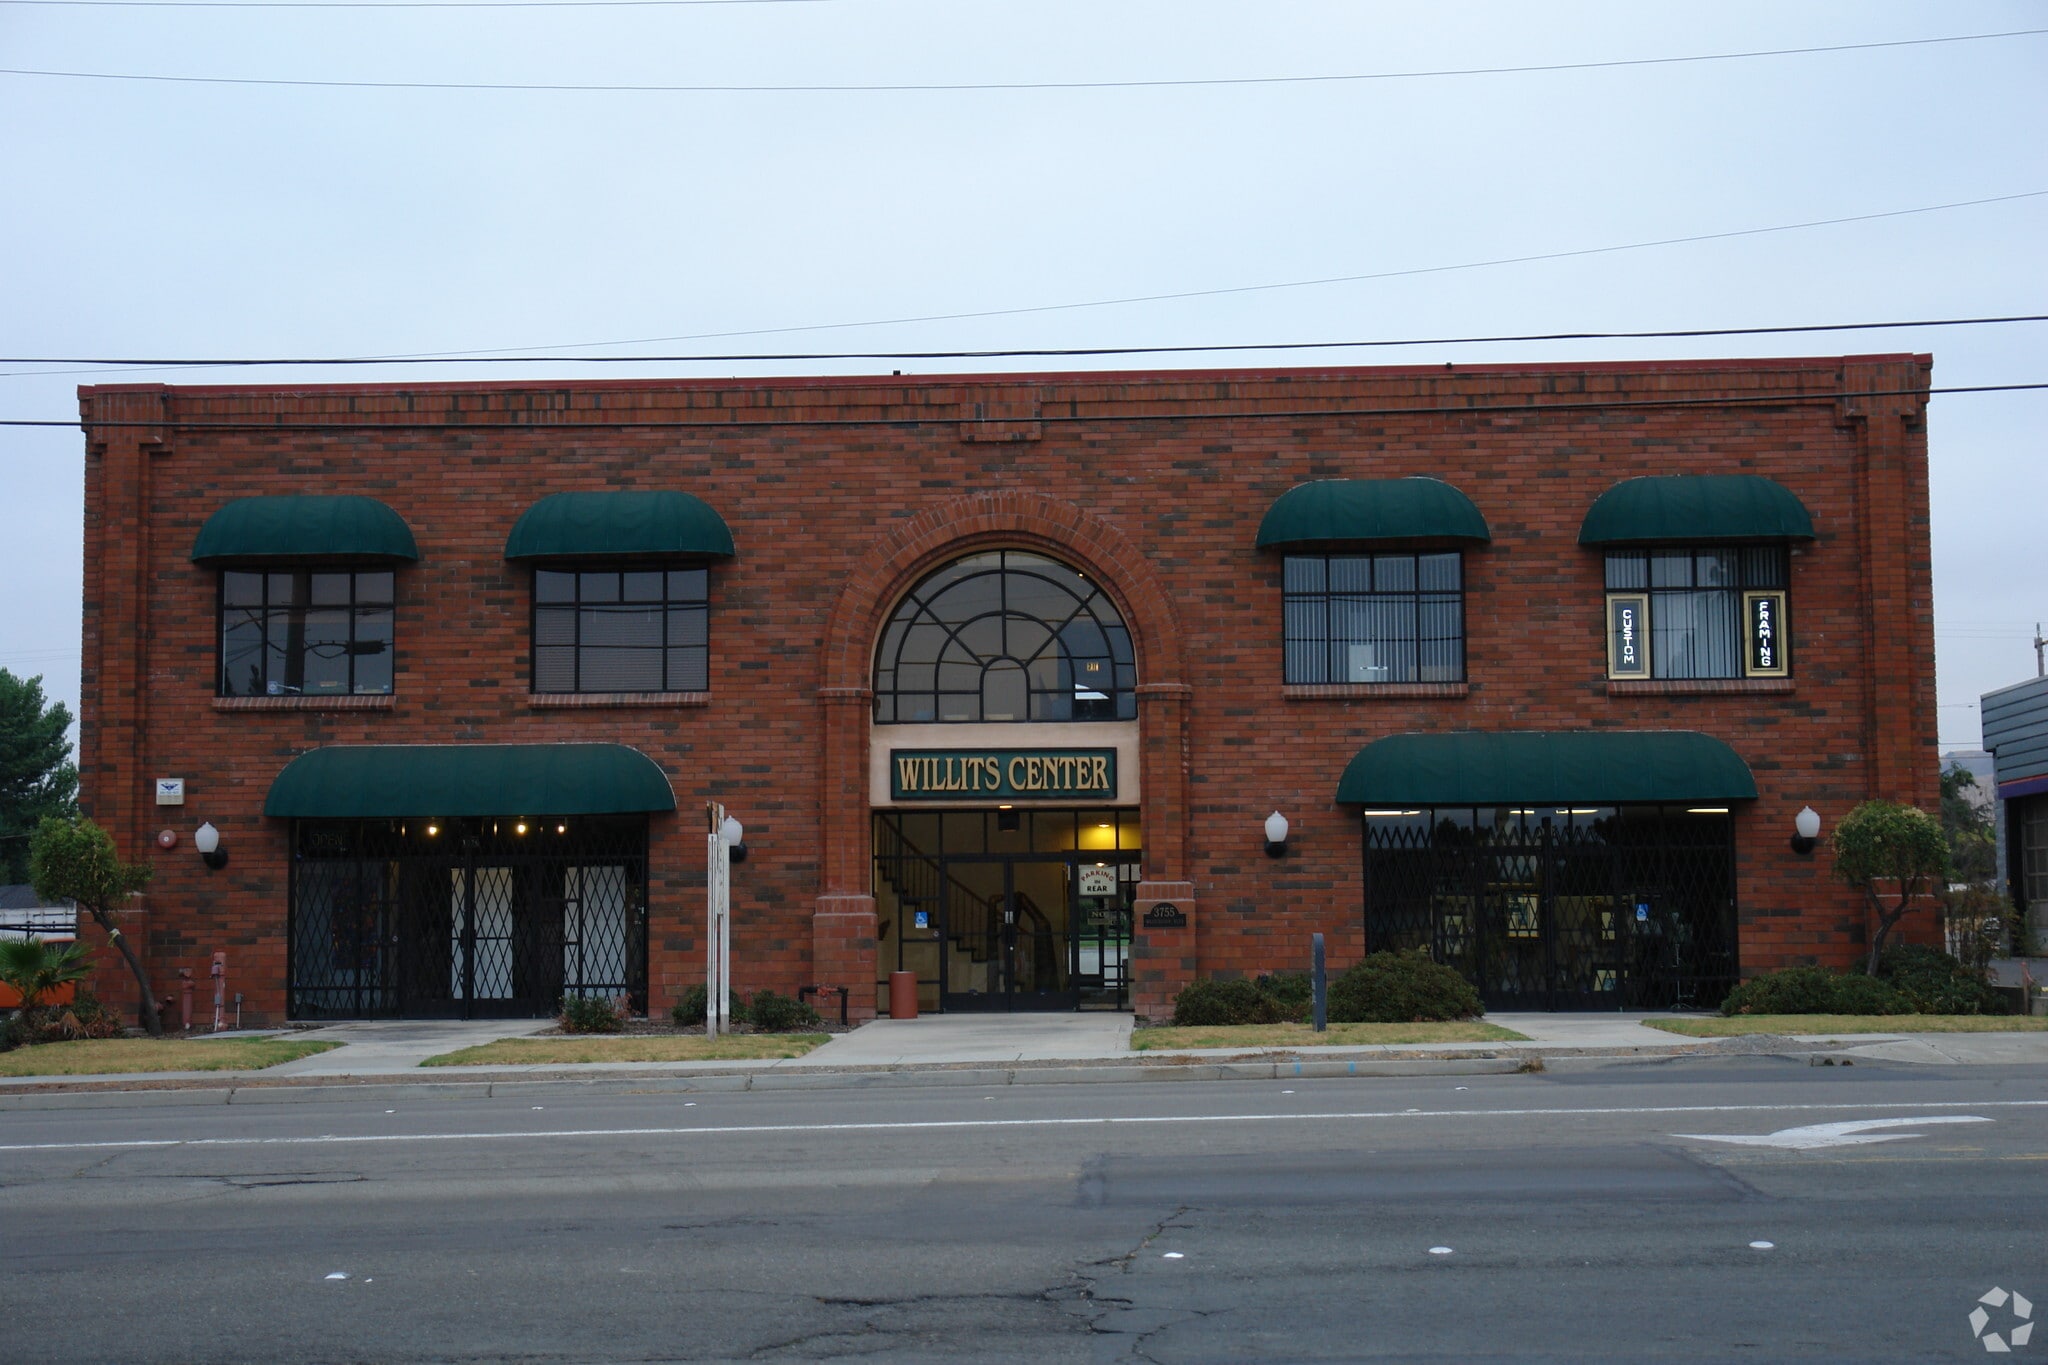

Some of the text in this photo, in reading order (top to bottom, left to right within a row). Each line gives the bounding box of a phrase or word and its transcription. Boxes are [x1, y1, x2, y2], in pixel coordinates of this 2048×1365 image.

[1622, 609, 1635, 664] CUSTOM
[1759, 601, 1771, 667] FRAMING
[898, 756, 1110, 791] WILLITS CENTER
[1081, 870, 1114, 882] PARKING
[1153, 907, 1175, 918] 3755
